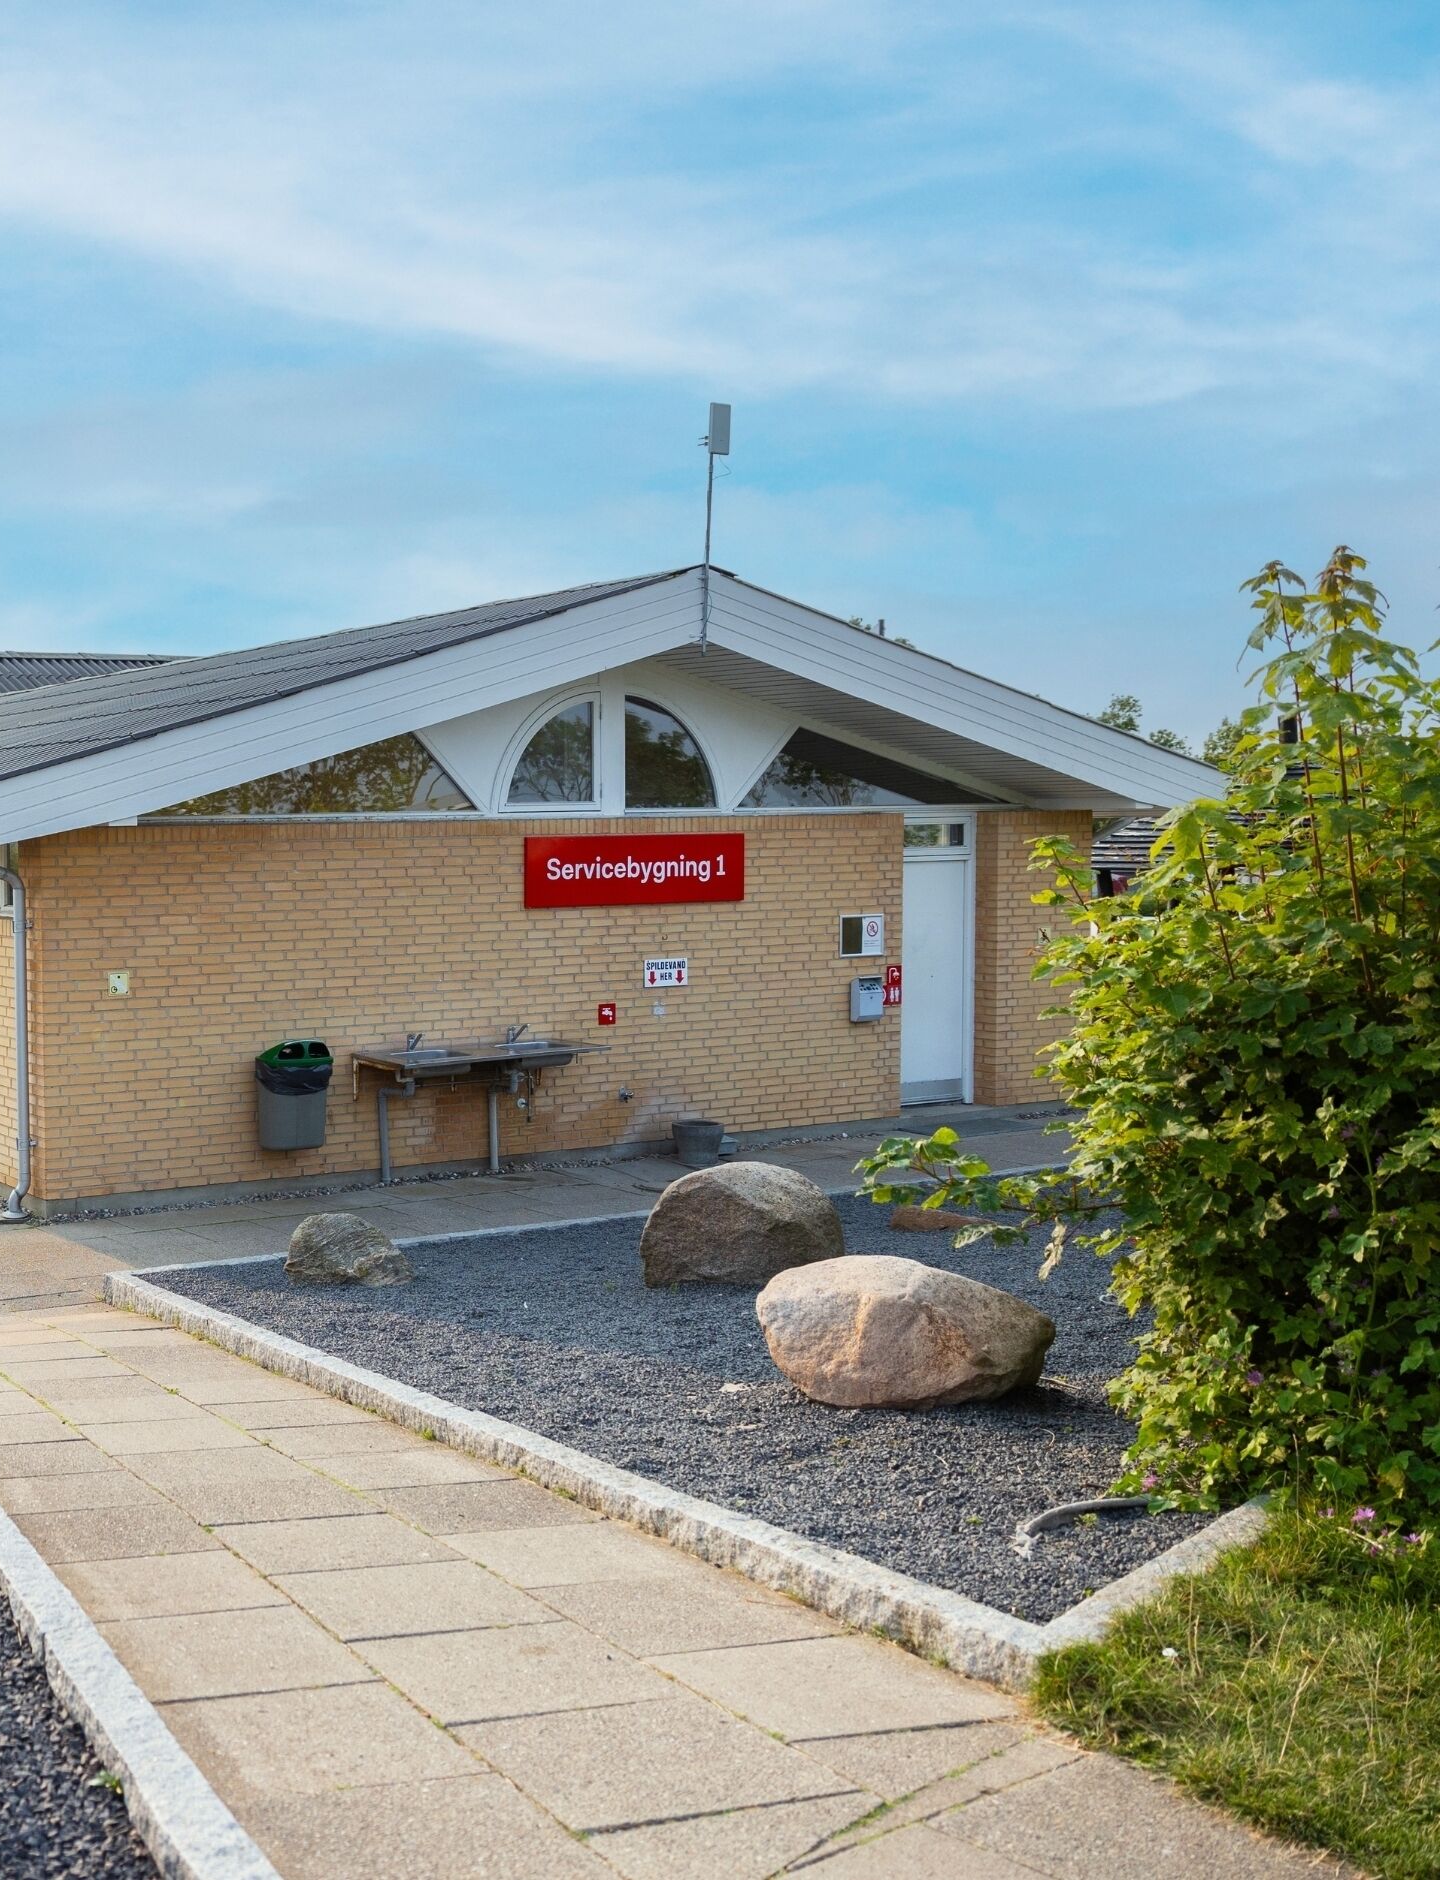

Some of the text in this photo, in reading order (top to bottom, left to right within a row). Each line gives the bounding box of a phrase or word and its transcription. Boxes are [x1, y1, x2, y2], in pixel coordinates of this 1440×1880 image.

[546, 854, 726, 883] Servicebygning 1
[646, 961, 686, 970] SPILDEVAND
[660, 972, 672, 980] HER
